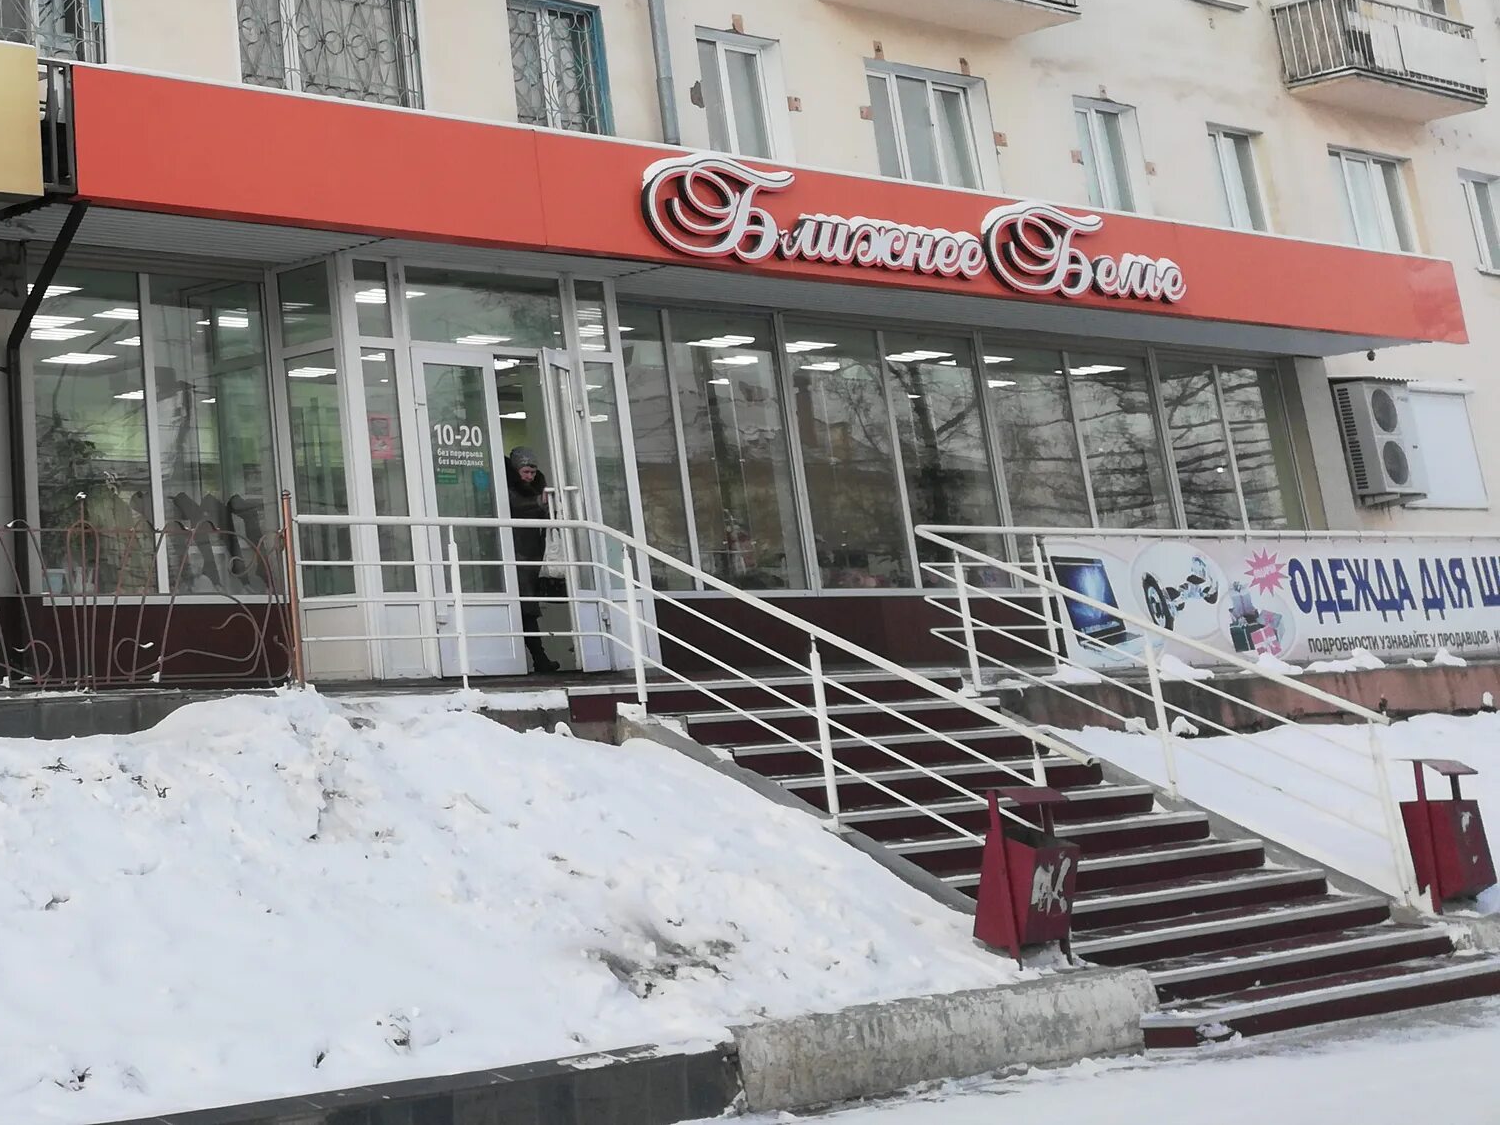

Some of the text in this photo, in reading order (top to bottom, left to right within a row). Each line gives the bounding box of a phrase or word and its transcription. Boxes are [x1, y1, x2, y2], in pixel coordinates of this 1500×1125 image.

[641, 155, 1187, 304] Ближнее Белье
[433, 424, 483, 447] 10-20
[1288, 556, 1500, 625] ОДЕЖДА ДЛЯ Ш
[1307, 635, 1380, 655] ПОДРОБНОСТИ
[1379, 630, 1431, 651] УЗНАВАЙТЕ
[1429, 633, 1438, 648] У
[1437, 630, 1490, 651] ПРОДАВЦОВ
